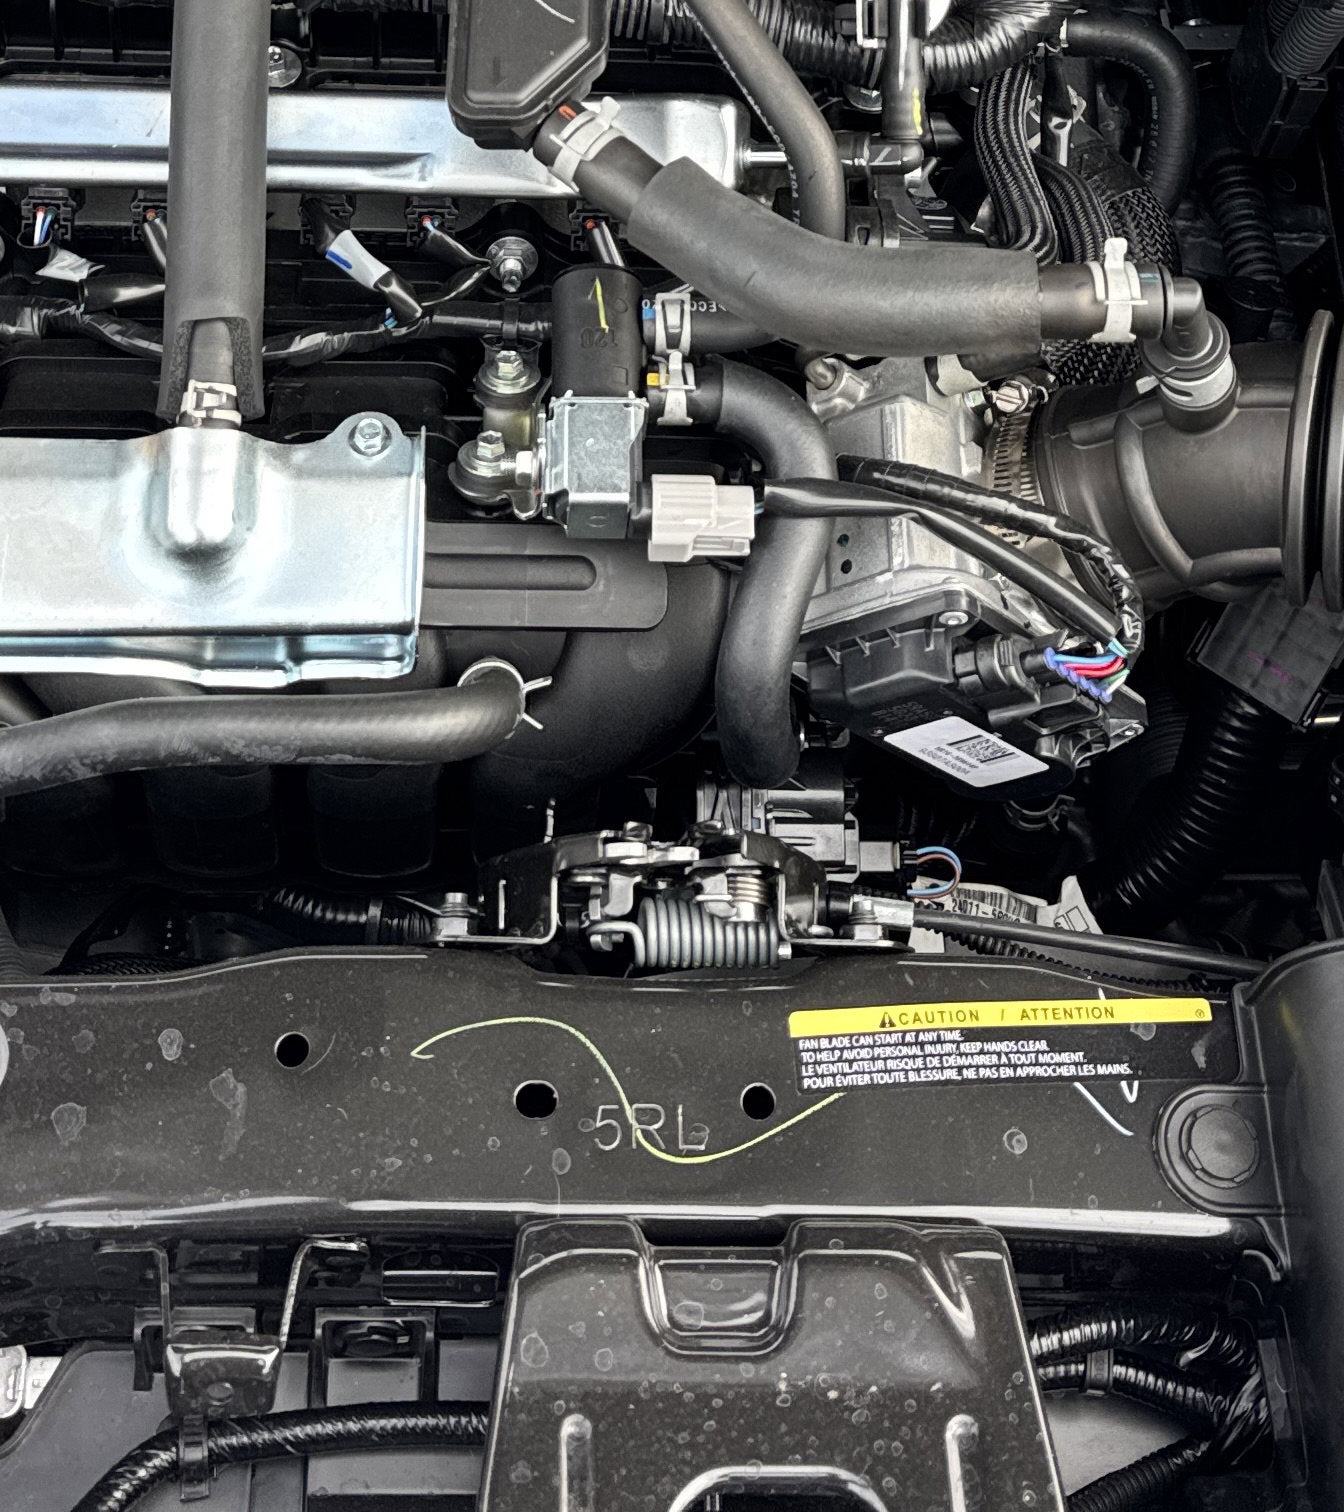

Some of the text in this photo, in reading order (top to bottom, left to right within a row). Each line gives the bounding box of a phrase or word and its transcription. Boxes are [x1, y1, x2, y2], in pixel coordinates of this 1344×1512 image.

[899, 1009, 980, 1026] CAUTION
[1020, 1006, 1115, 1022] ATTENTION
[799, 1039, 819, 1051] FAN
[820, 1037, 851, 1049] BLADE
[852, 1035, 874, 1046] CAN
[875, 1033, 903, 1045] START
[904, 1032, 916, 1044] AT
[918, 1031, 938, 1042] ANY
[800, 1052, 815, 1063] TO
[816, 1050, 841, 1062] HELP
[842, 1048, 872, 1060] AVOID
[873, 1045, 924, 1058] PERSONAL
[925, 1043, 959, 1055] INJURY,
[960, 1042, 983, 1053] KEEP
[983, 1040, 1017, 1053] HANDS
[801, 1051, 1087, 1077] LE VENTILATEUR RISQUE DE DÉMARRER À TOUT MOMENT.
[803, 1063, 1133, 1089] POUR ÉVITER TOUTE BLESSURE, NE PAS EN APPROCHER LES MAINS.
[595, 1103, 707, 1151] 5RL
